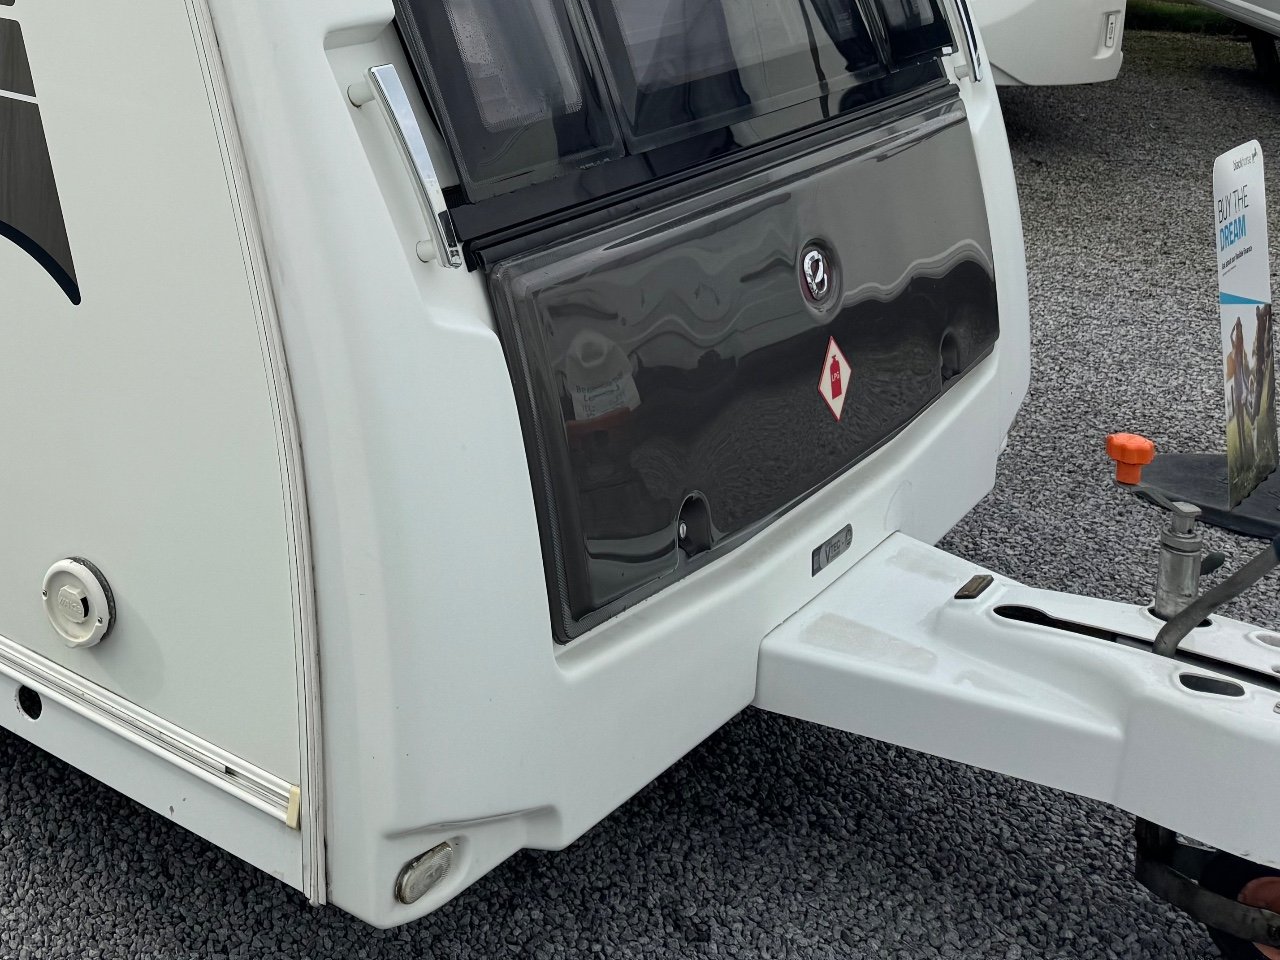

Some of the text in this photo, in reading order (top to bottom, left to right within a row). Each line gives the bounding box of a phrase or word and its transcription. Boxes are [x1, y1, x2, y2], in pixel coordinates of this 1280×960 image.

[1217, 184, 1249, 224] BUY THE
[1219, 214, 1247, 252] DREAM
